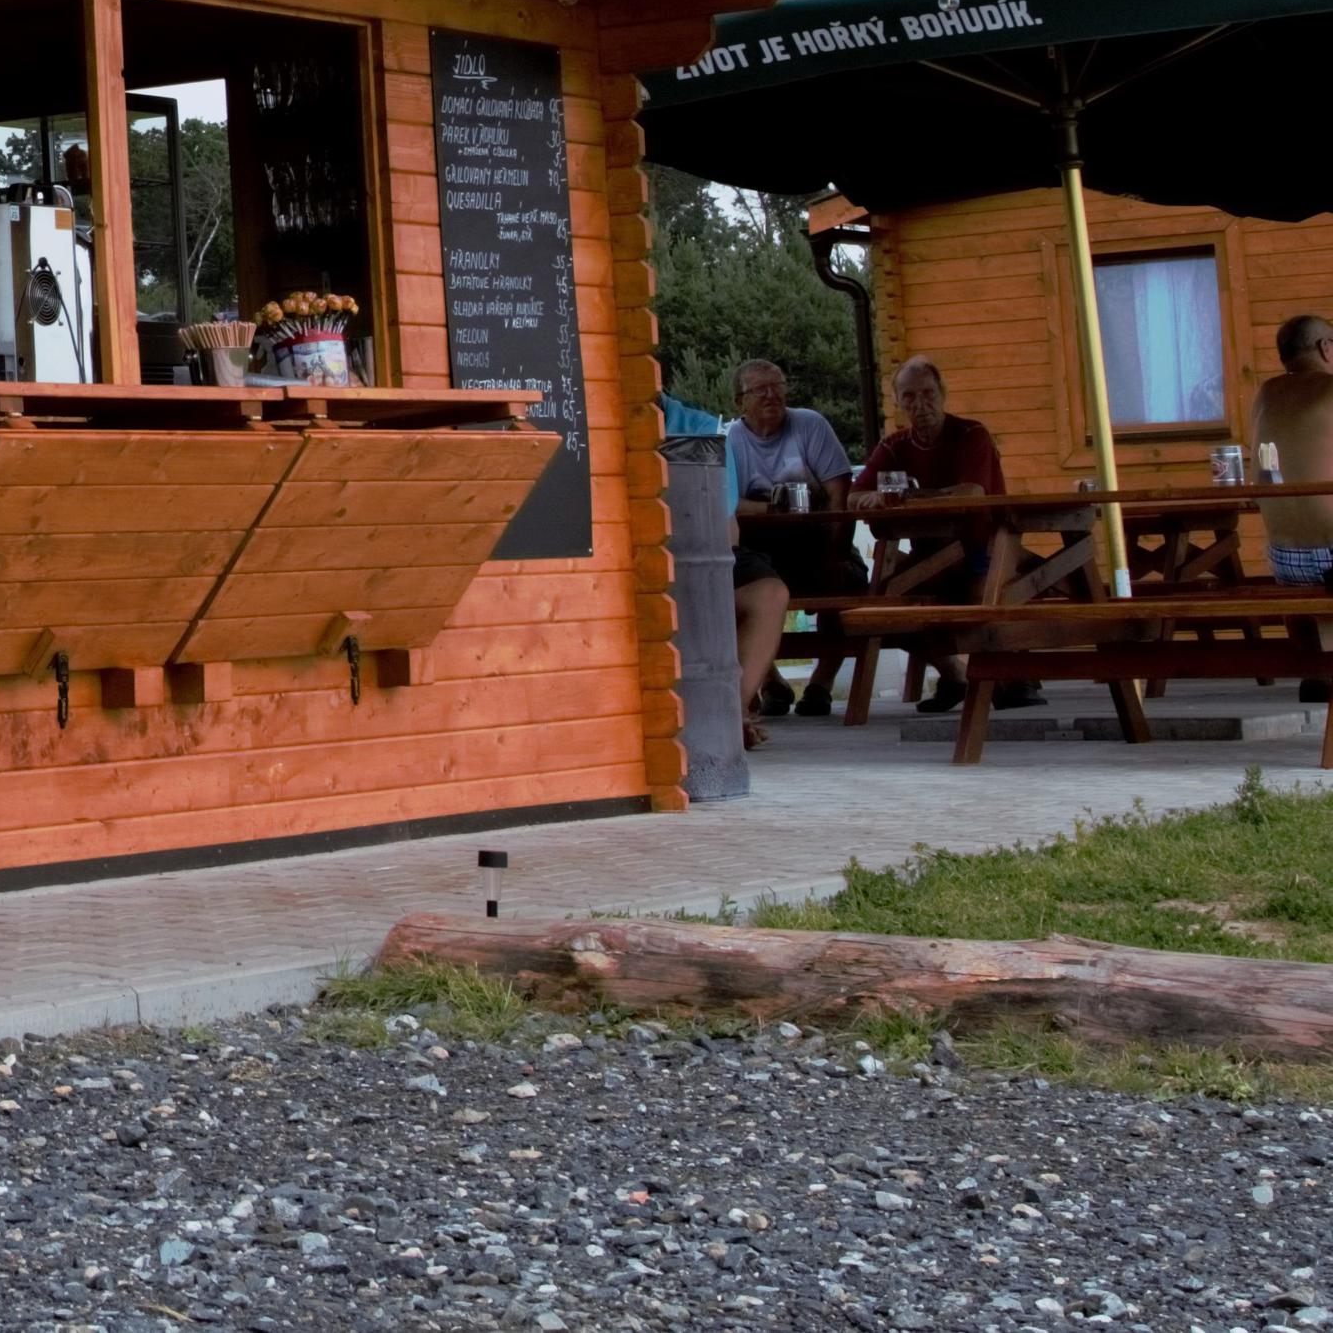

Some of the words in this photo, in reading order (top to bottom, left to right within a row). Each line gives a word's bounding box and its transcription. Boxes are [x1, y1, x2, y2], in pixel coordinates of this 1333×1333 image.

[761, 36, 791, 65] JE
[795, 15, 898, 56] HOŘKÝ.
[453, 40, 486, 76] JÍDLO
[441, 117, 470, 144] PÁREK
[447, 190, 501, 211] QUESADILLA
[450, 250, 500, 272] HRANOLKY
[493, 275, 532, 290] HRANOLKY
[456, 329, 488, 344] MELOUN
[457, 351, 490, 367] NACHOS
